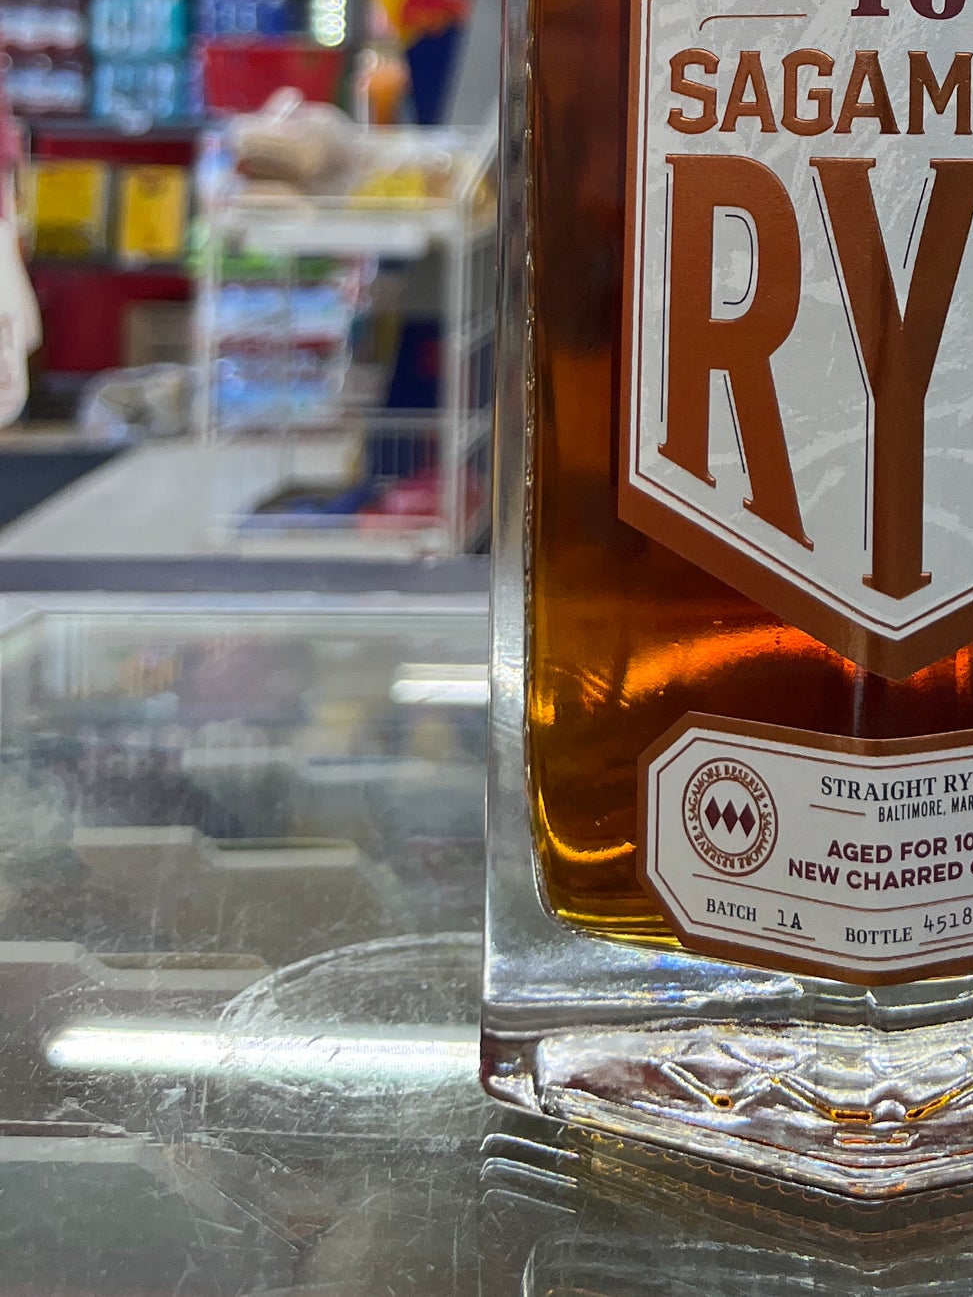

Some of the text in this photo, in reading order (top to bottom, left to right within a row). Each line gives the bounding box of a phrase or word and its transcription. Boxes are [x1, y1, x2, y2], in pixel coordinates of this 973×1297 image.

[820, 775, 938, 802] STRAIGHT
[877, 798, 947, 823] BALTIMORE,
[826, 839, 893, 864] AGED
[899, 836, 948, 861] FOR
[787, 857, 840, 886] NEW
[845, 860, 964, 891] CHARRED
[705, 897, 757, 922] BATCH
[844, 926, 913, 945] BOTTLE
[922, 906, 973, 935] 4518
